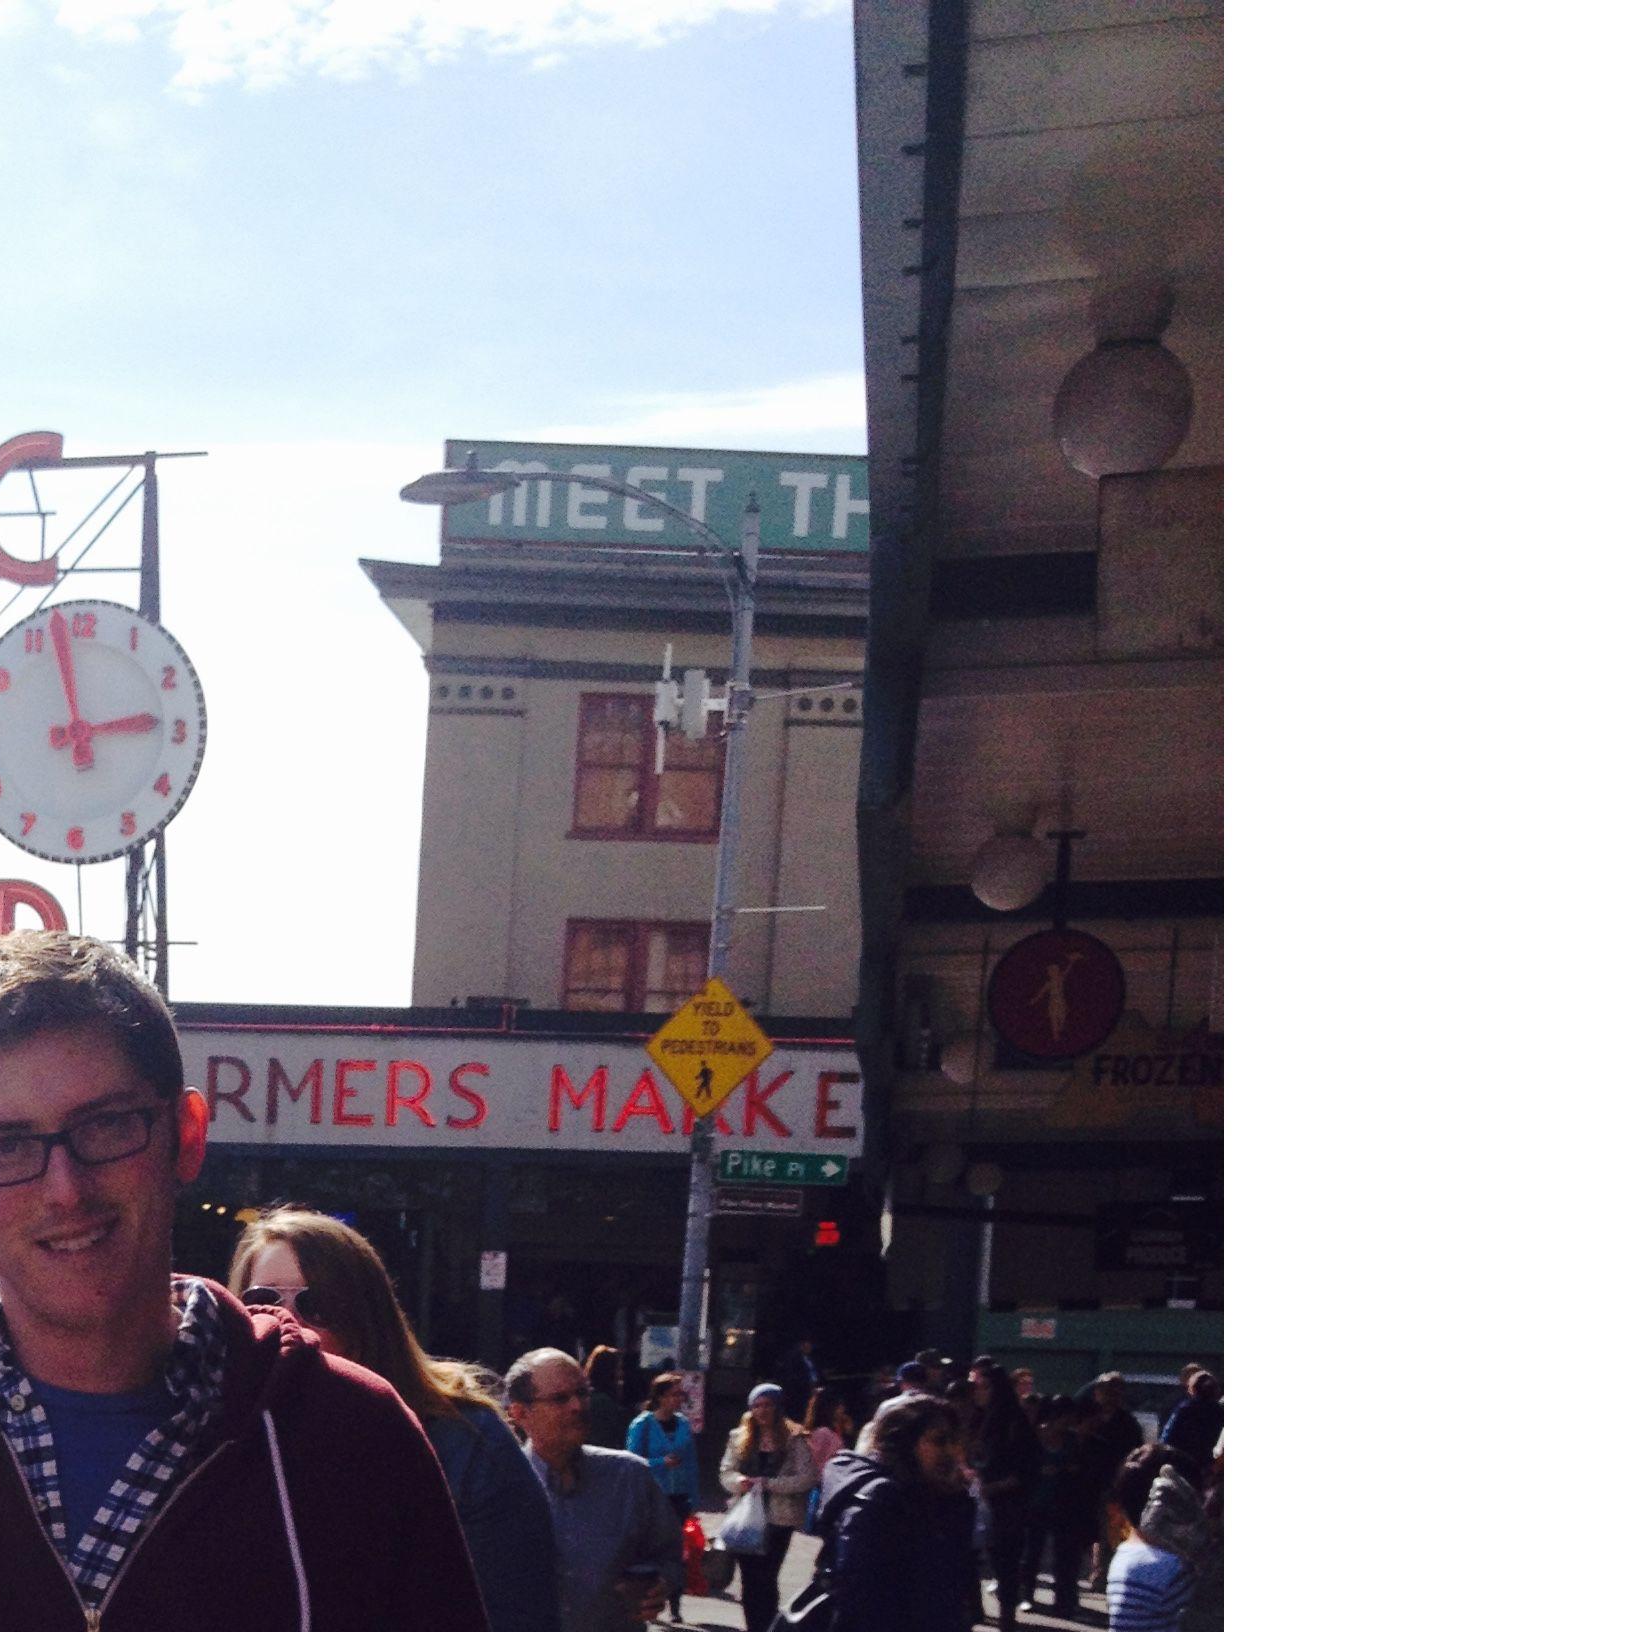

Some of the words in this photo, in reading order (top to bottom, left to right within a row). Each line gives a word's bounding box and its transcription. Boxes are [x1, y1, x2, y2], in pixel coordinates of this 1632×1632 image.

[487, 459, 724, 533] MEET
[71, 612, 97, 639] 12
[129, 626, 139, 651] 1
[23, 628, 44, 654] 11
[160, 664, 177, 690] 2
[171, 718, 187, 744] 3
[153, 772, 172, 798] 4
[20, 811, 38, 837] 7
[120, 810, 138, 837] 5
[65, 827, 85, 851] 6
[692, 1001, 735, 1017] YIELD
[701, 1020, 720, 1036] TO
[660, 1039, 757, 1056] PEDESTRIANS
[206, 1055, 490, 1130] RMERS
[726, 1151, 777, 1177] Pike
